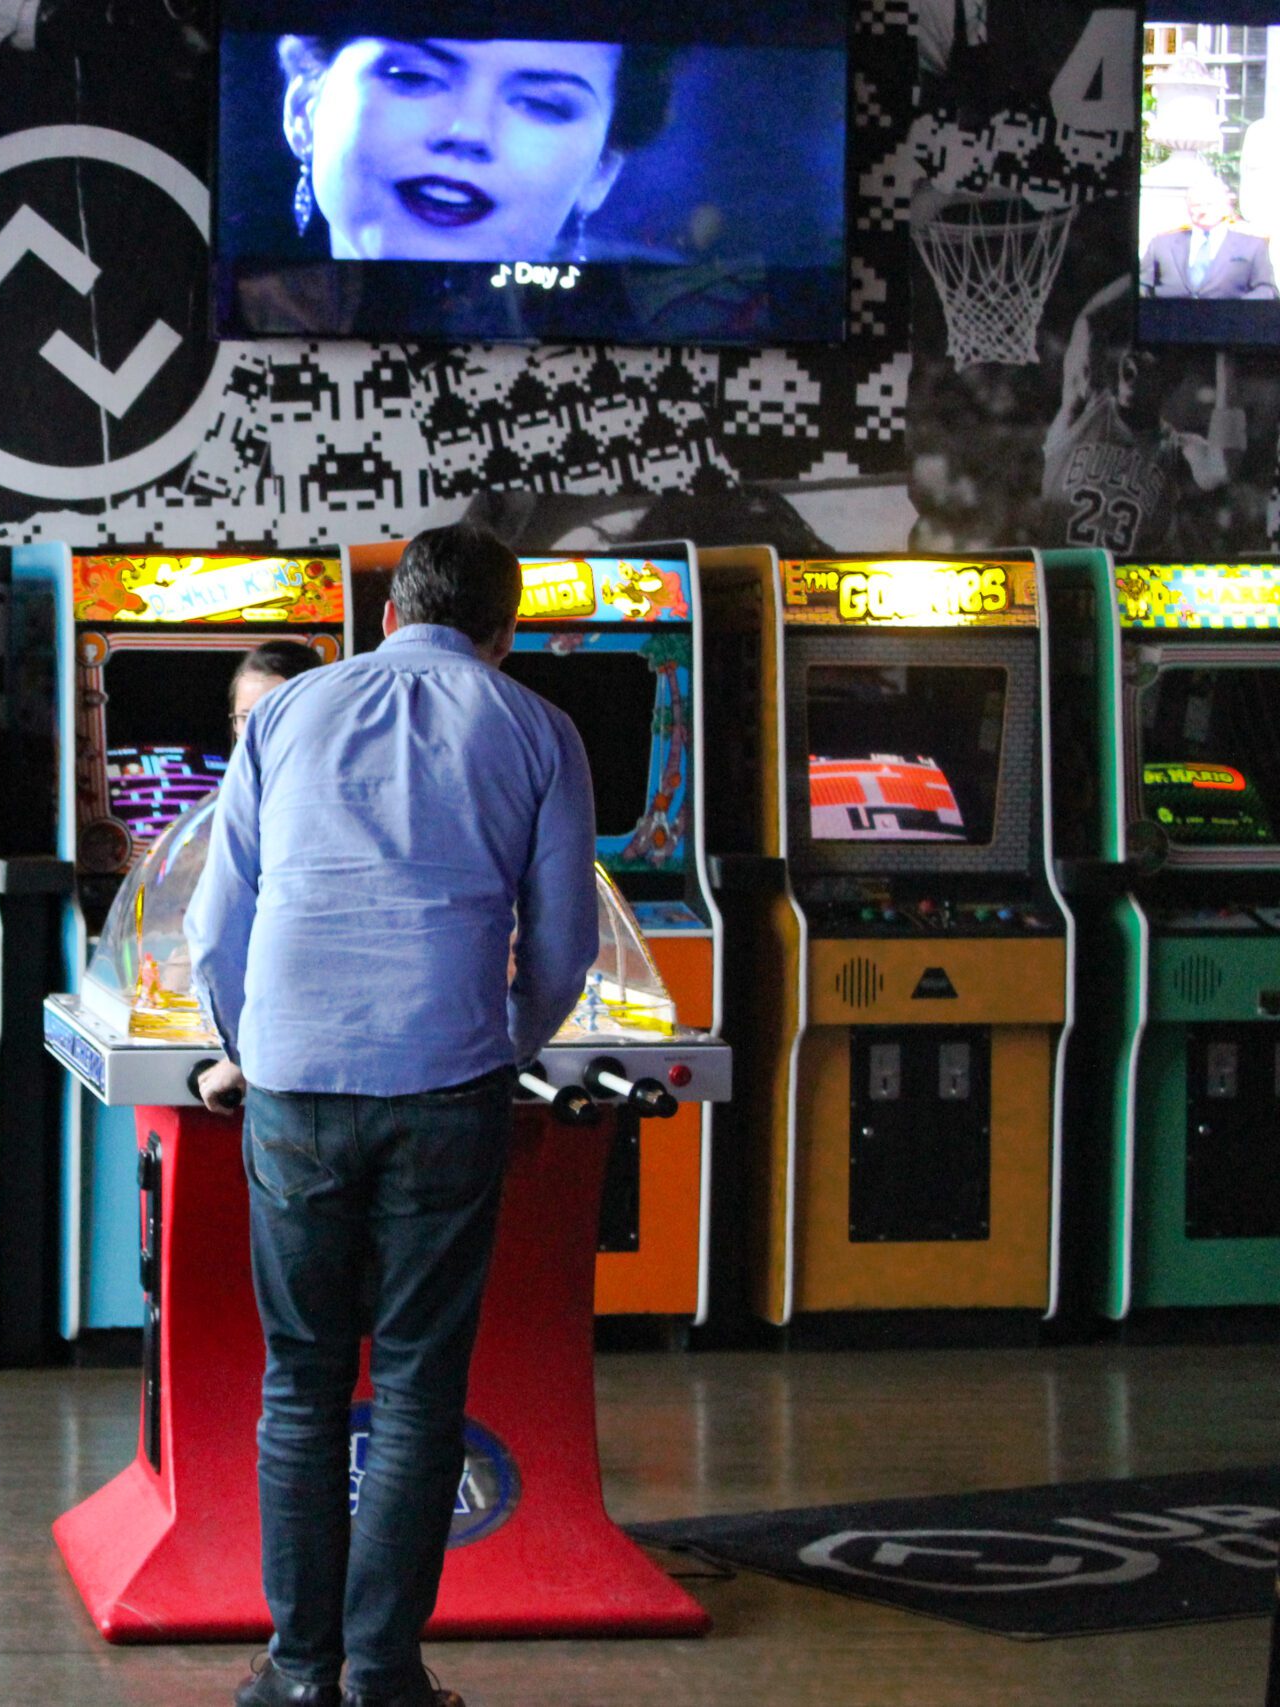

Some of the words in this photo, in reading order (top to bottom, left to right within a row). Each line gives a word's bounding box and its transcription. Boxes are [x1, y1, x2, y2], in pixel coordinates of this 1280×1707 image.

[515, 261, 559, 289] Day
[1063, 444, 1166, 515] BULLS
[1066, 485, 1142, 556] 23
[148, 583, 231, 617] DNKEY
[802, 571, 840, 592] THE
[838, 566, 1008, 620] GONIES
[1168, 768, 1235, 784] MARIO
